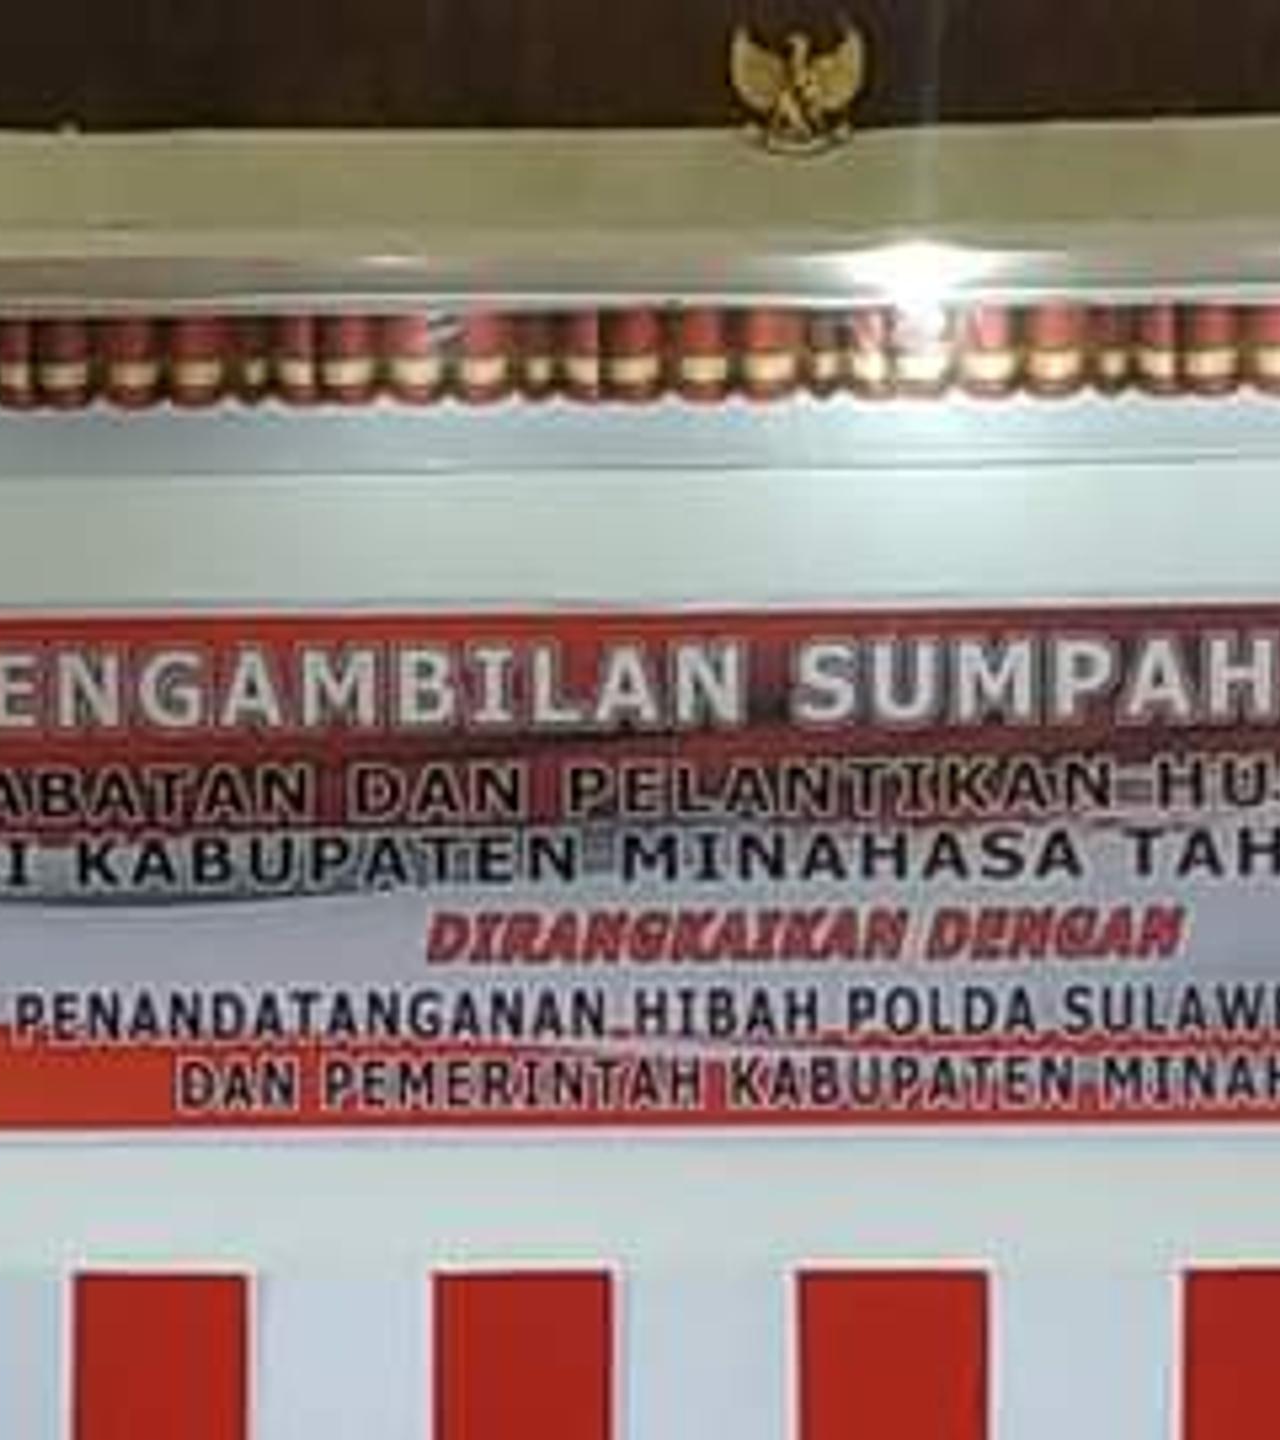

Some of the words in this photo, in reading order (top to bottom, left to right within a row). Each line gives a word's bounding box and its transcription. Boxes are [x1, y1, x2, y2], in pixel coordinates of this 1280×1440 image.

[353, 763, 523, 817] DAN
[567, 757, 1113, 815] PELANTIKAN
[73, 830, 580, 888] KABUPATEN
[620, 826, 1087, 884] MINAHASA
[423, 908, 910, 965] DIRANGKAIKAN
[924, 904, 1186, 961] DENGAN
[13, 988, 609, 1042] PENANDATANGANAN
[631, 985, 821, 1038] HIBAH
[845, 984, 1039, 1037] POLDA
[177, 1057, 298, 1110] DAN
[325, 1055, 702, 1110] PEMERINTAH
[728, 1053, 1074, 1105] KABUPATEN
